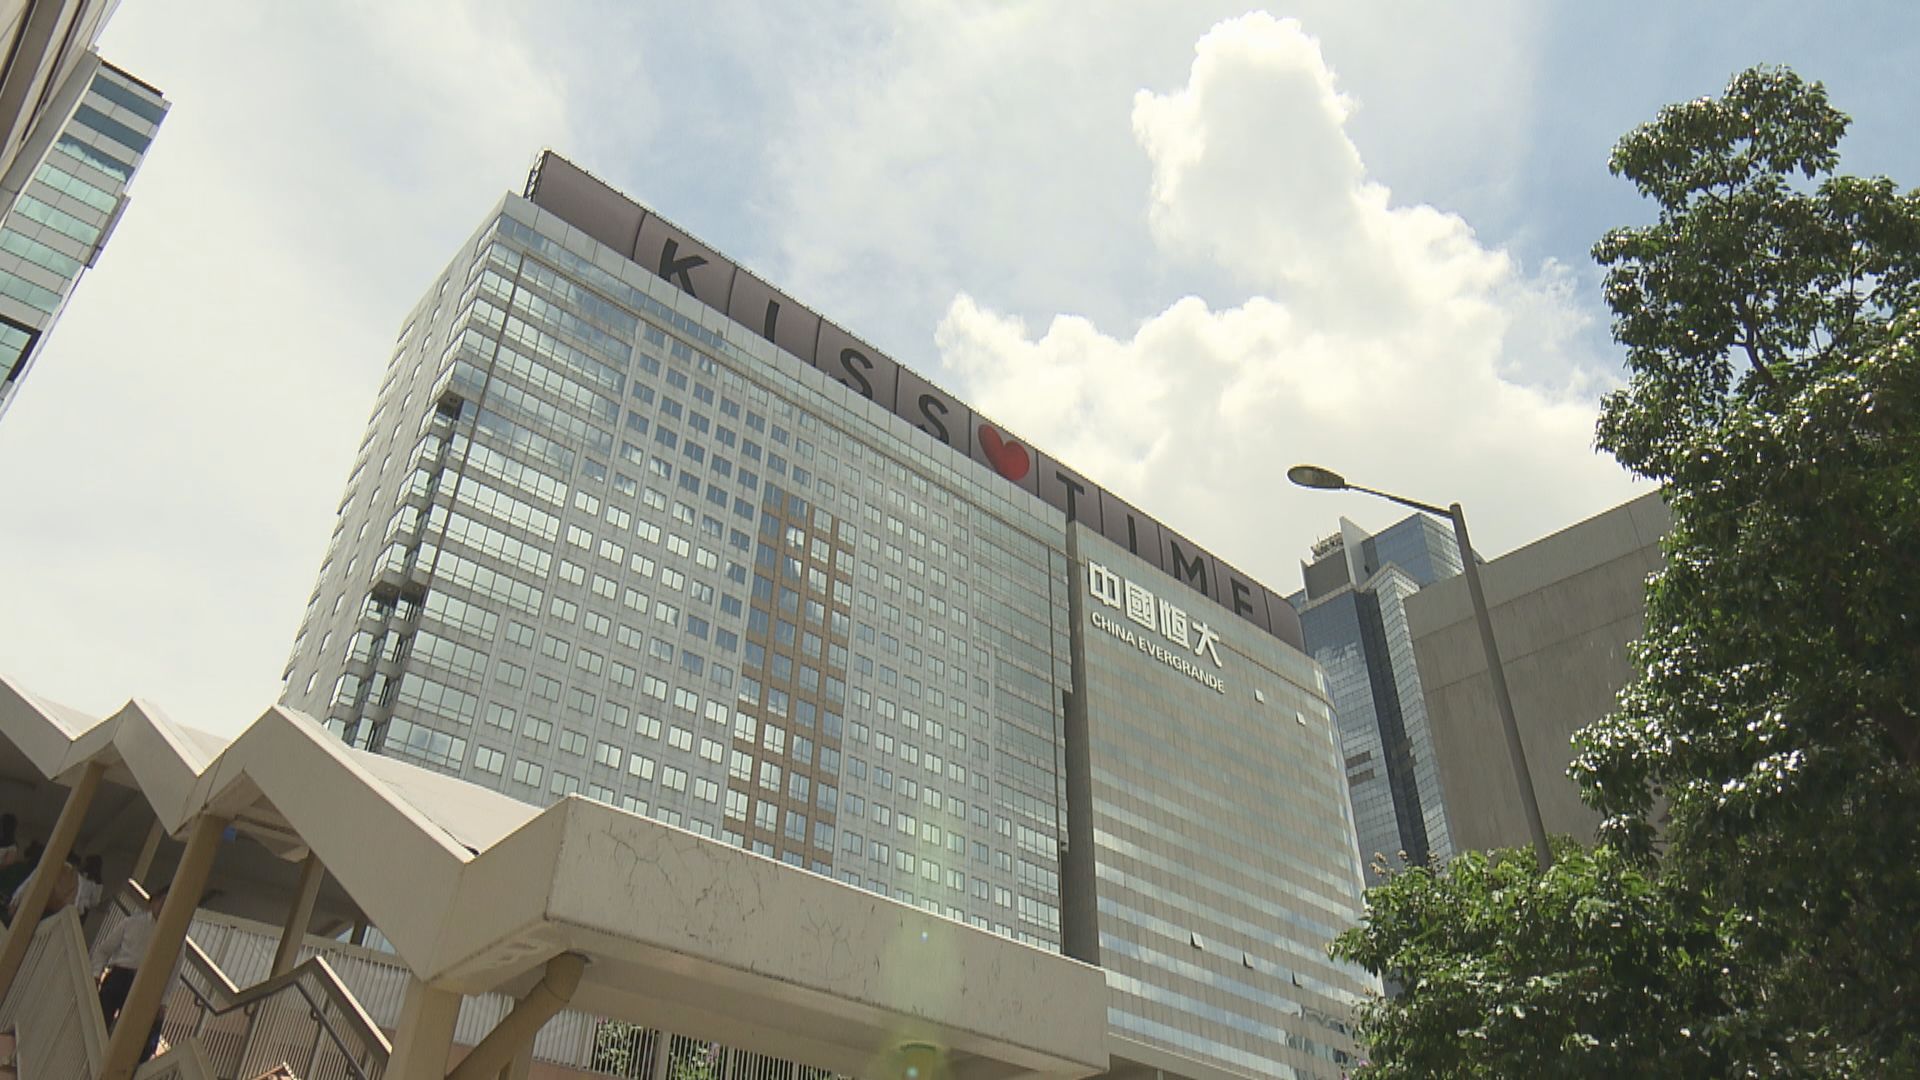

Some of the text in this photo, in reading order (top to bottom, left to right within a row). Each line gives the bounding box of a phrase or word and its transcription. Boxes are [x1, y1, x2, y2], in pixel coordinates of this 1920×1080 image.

[658, 238, 950, 444] KISS
[1089, 560, 1222, 667] 中國恒大
[1091, 612, 1225, 694] CHINA EVERGRANDE
